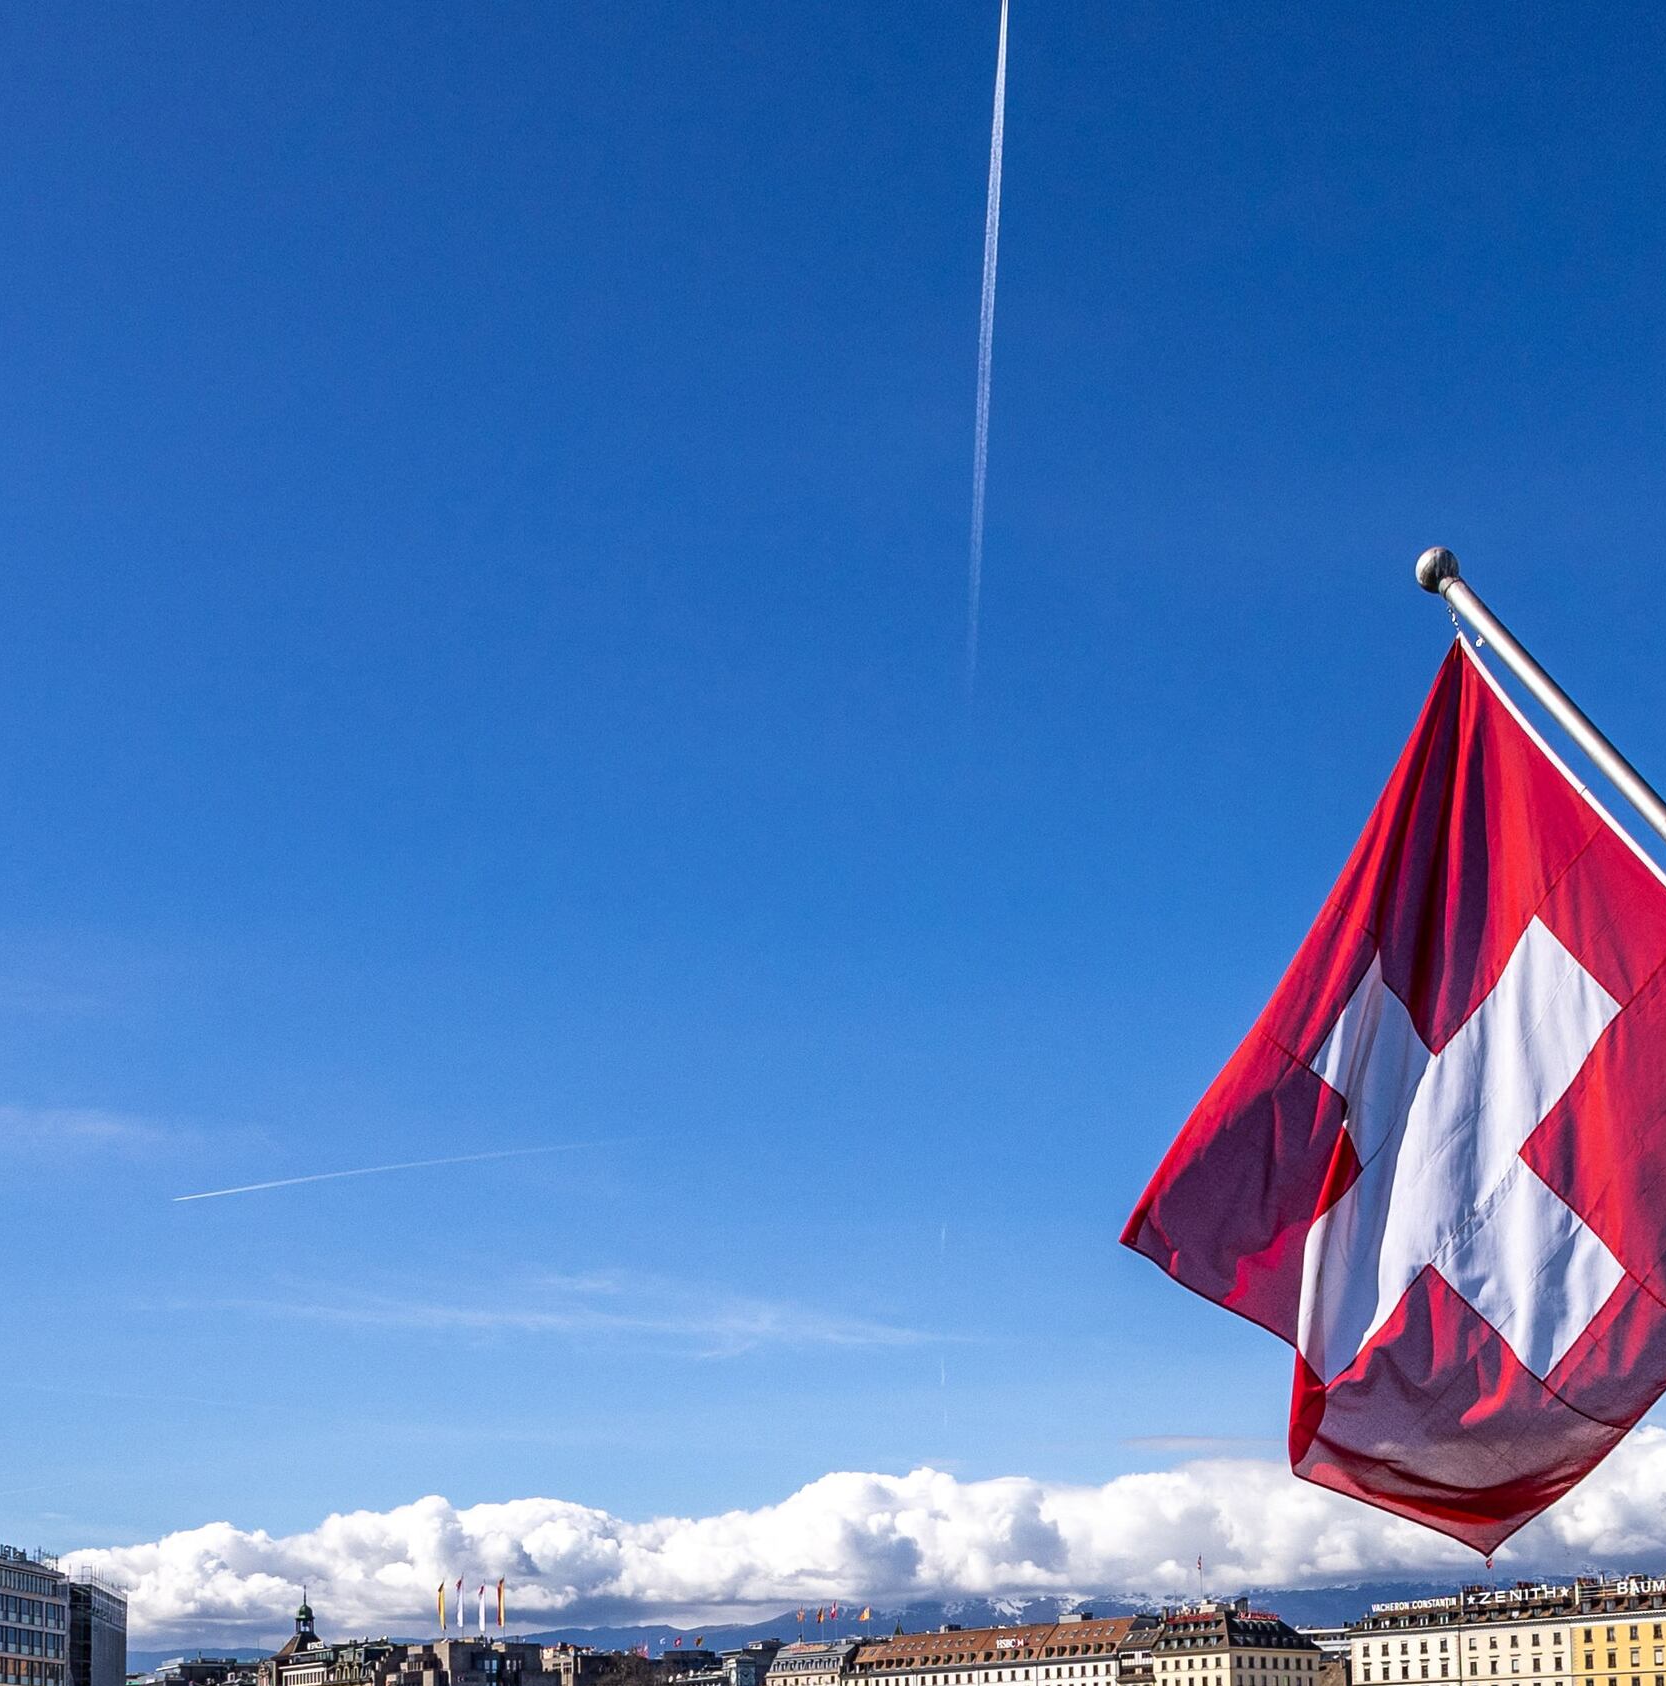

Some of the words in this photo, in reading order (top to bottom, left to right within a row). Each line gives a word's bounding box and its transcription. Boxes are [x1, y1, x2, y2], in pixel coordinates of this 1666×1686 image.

[1479, 1584, 1557, 1605] ZENITH
[1371, 1600, 1410, 1613] VACHERON
[1411, 1596, 1457, 1610] CONSTANTIN
[996, 1639, 1017, 1649] HSBC
